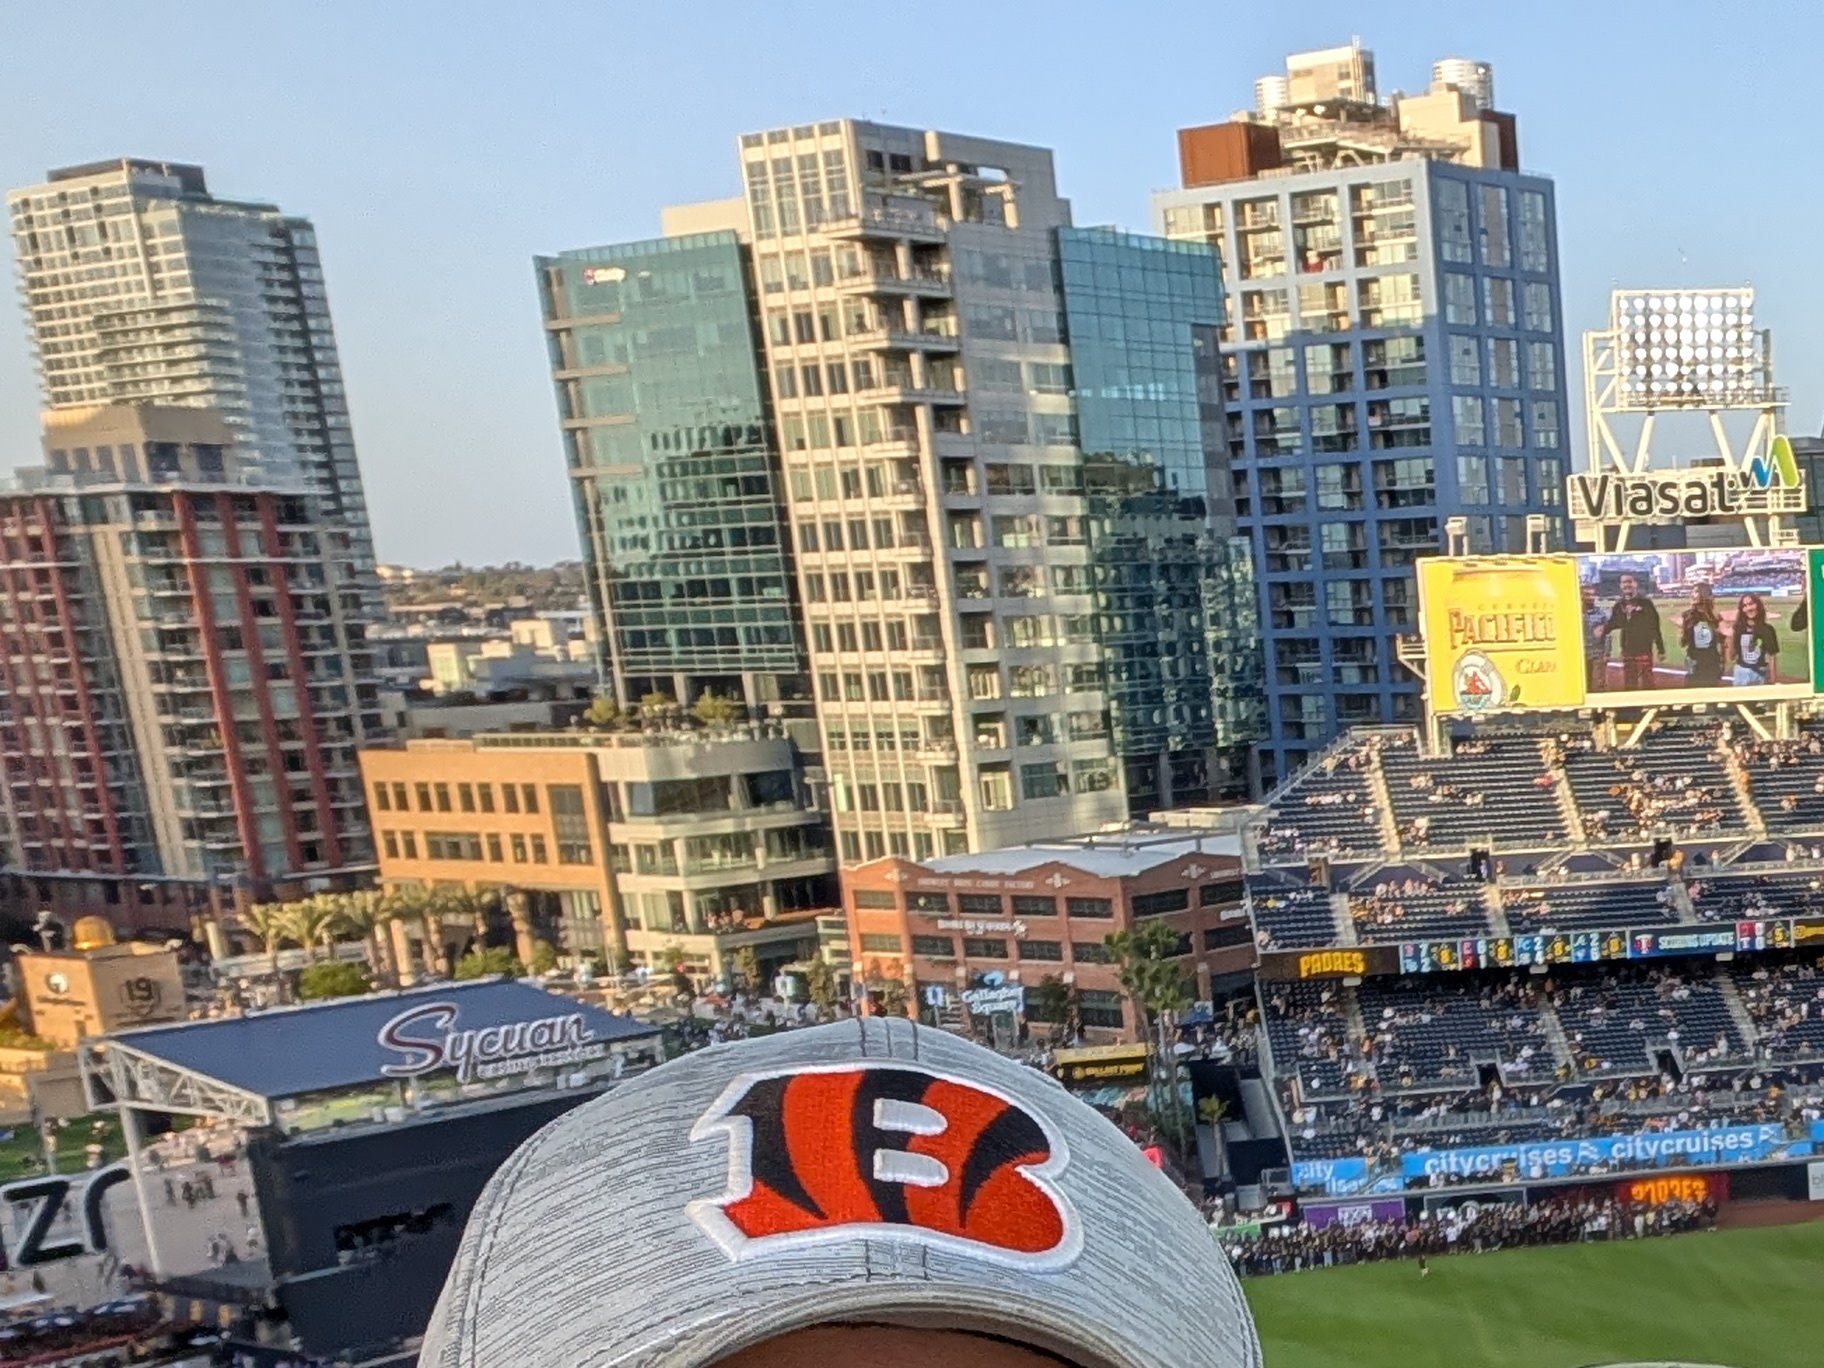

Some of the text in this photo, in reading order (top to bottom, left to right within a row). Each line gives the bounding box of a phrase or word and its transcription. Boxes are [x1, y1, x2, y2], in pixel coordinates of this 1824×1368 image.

[1577, 472, 1735, 518] Viasat
[1299, 951, 1365, 980] PADRES
[126, 976, 154, 1002] 19
[377, 1001, 595, 1085] Sycuan
[1611, 1131, 1754, 1161] citycruises
